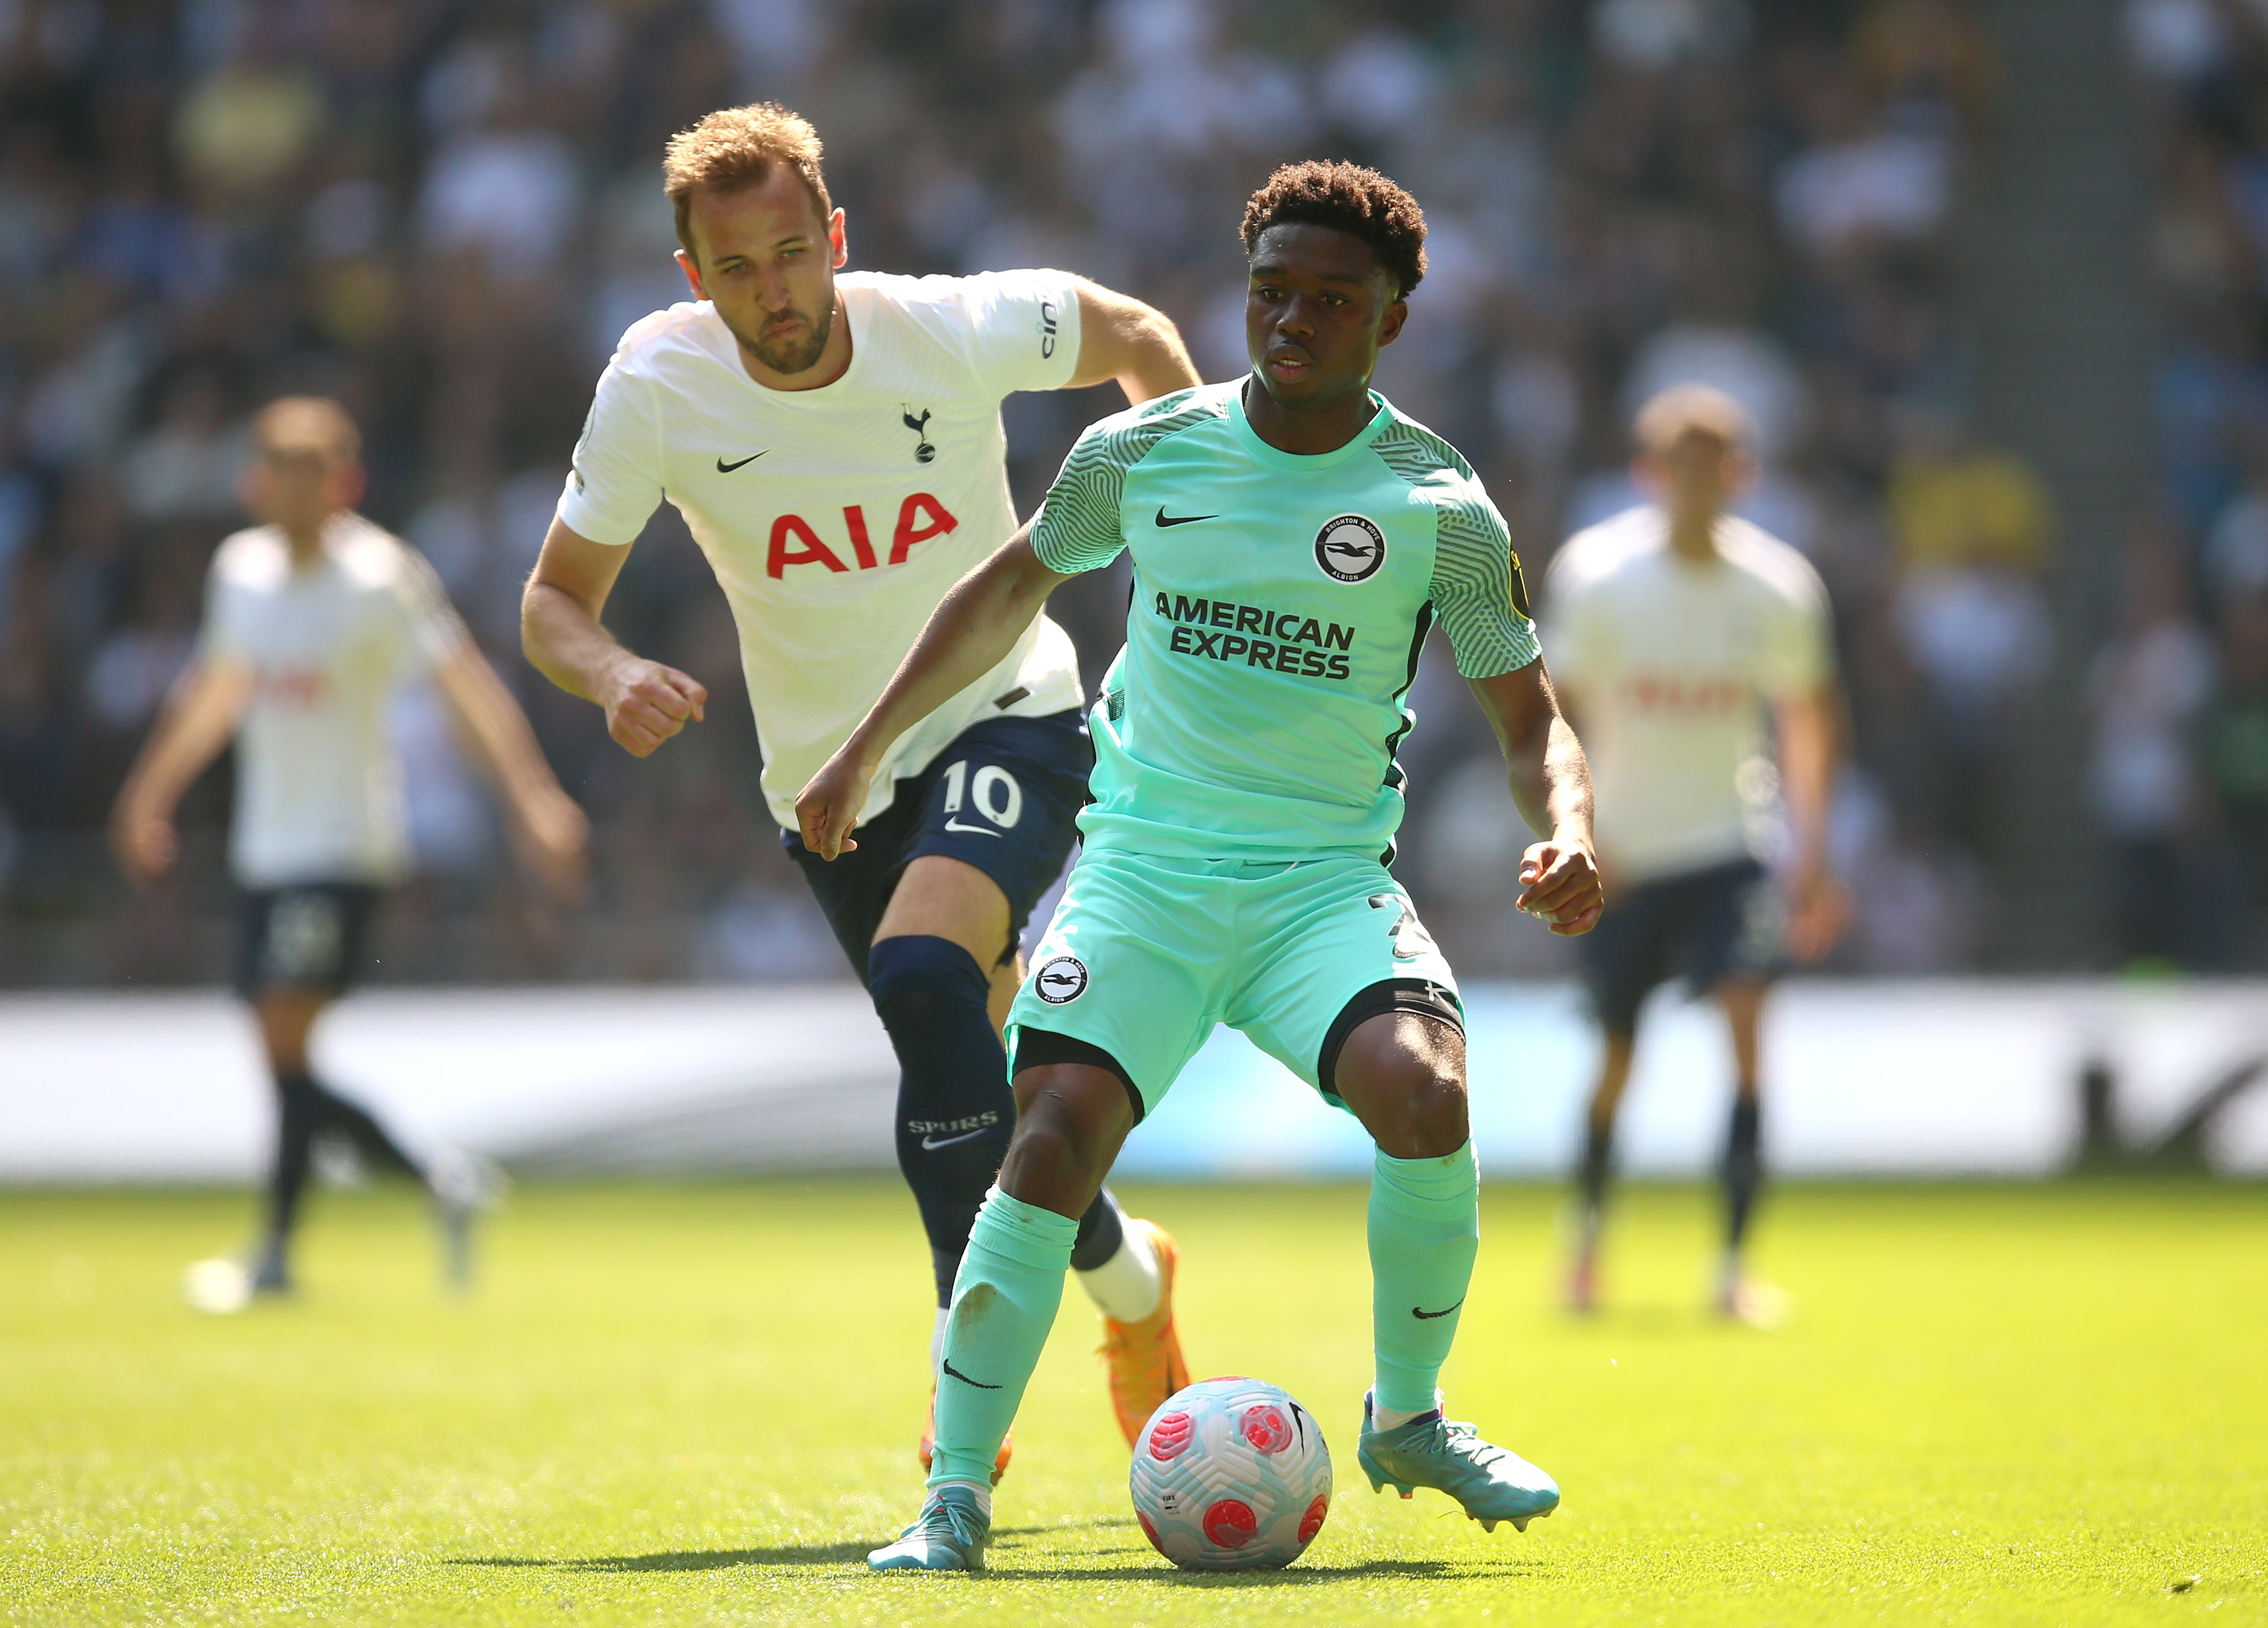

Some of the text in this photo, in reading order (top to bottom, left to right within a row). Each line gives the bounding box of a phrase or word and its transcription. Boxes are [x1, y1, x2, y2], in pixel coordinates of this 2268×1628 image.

[767, 492, 958, 580] AIA
[1325, 518, 1358, 533] BRIGHTON
[1367, 525, 1380, 541] HOVE
[1332, 571, 1358, 581] ALBION
[1156, 591, 1355, 651] AMERICAN
[1170, 626, 1350, 680] EXPRESS
[943, 759, 1023, 829] 10
[908, 1111, 998, 1133] SPURS
